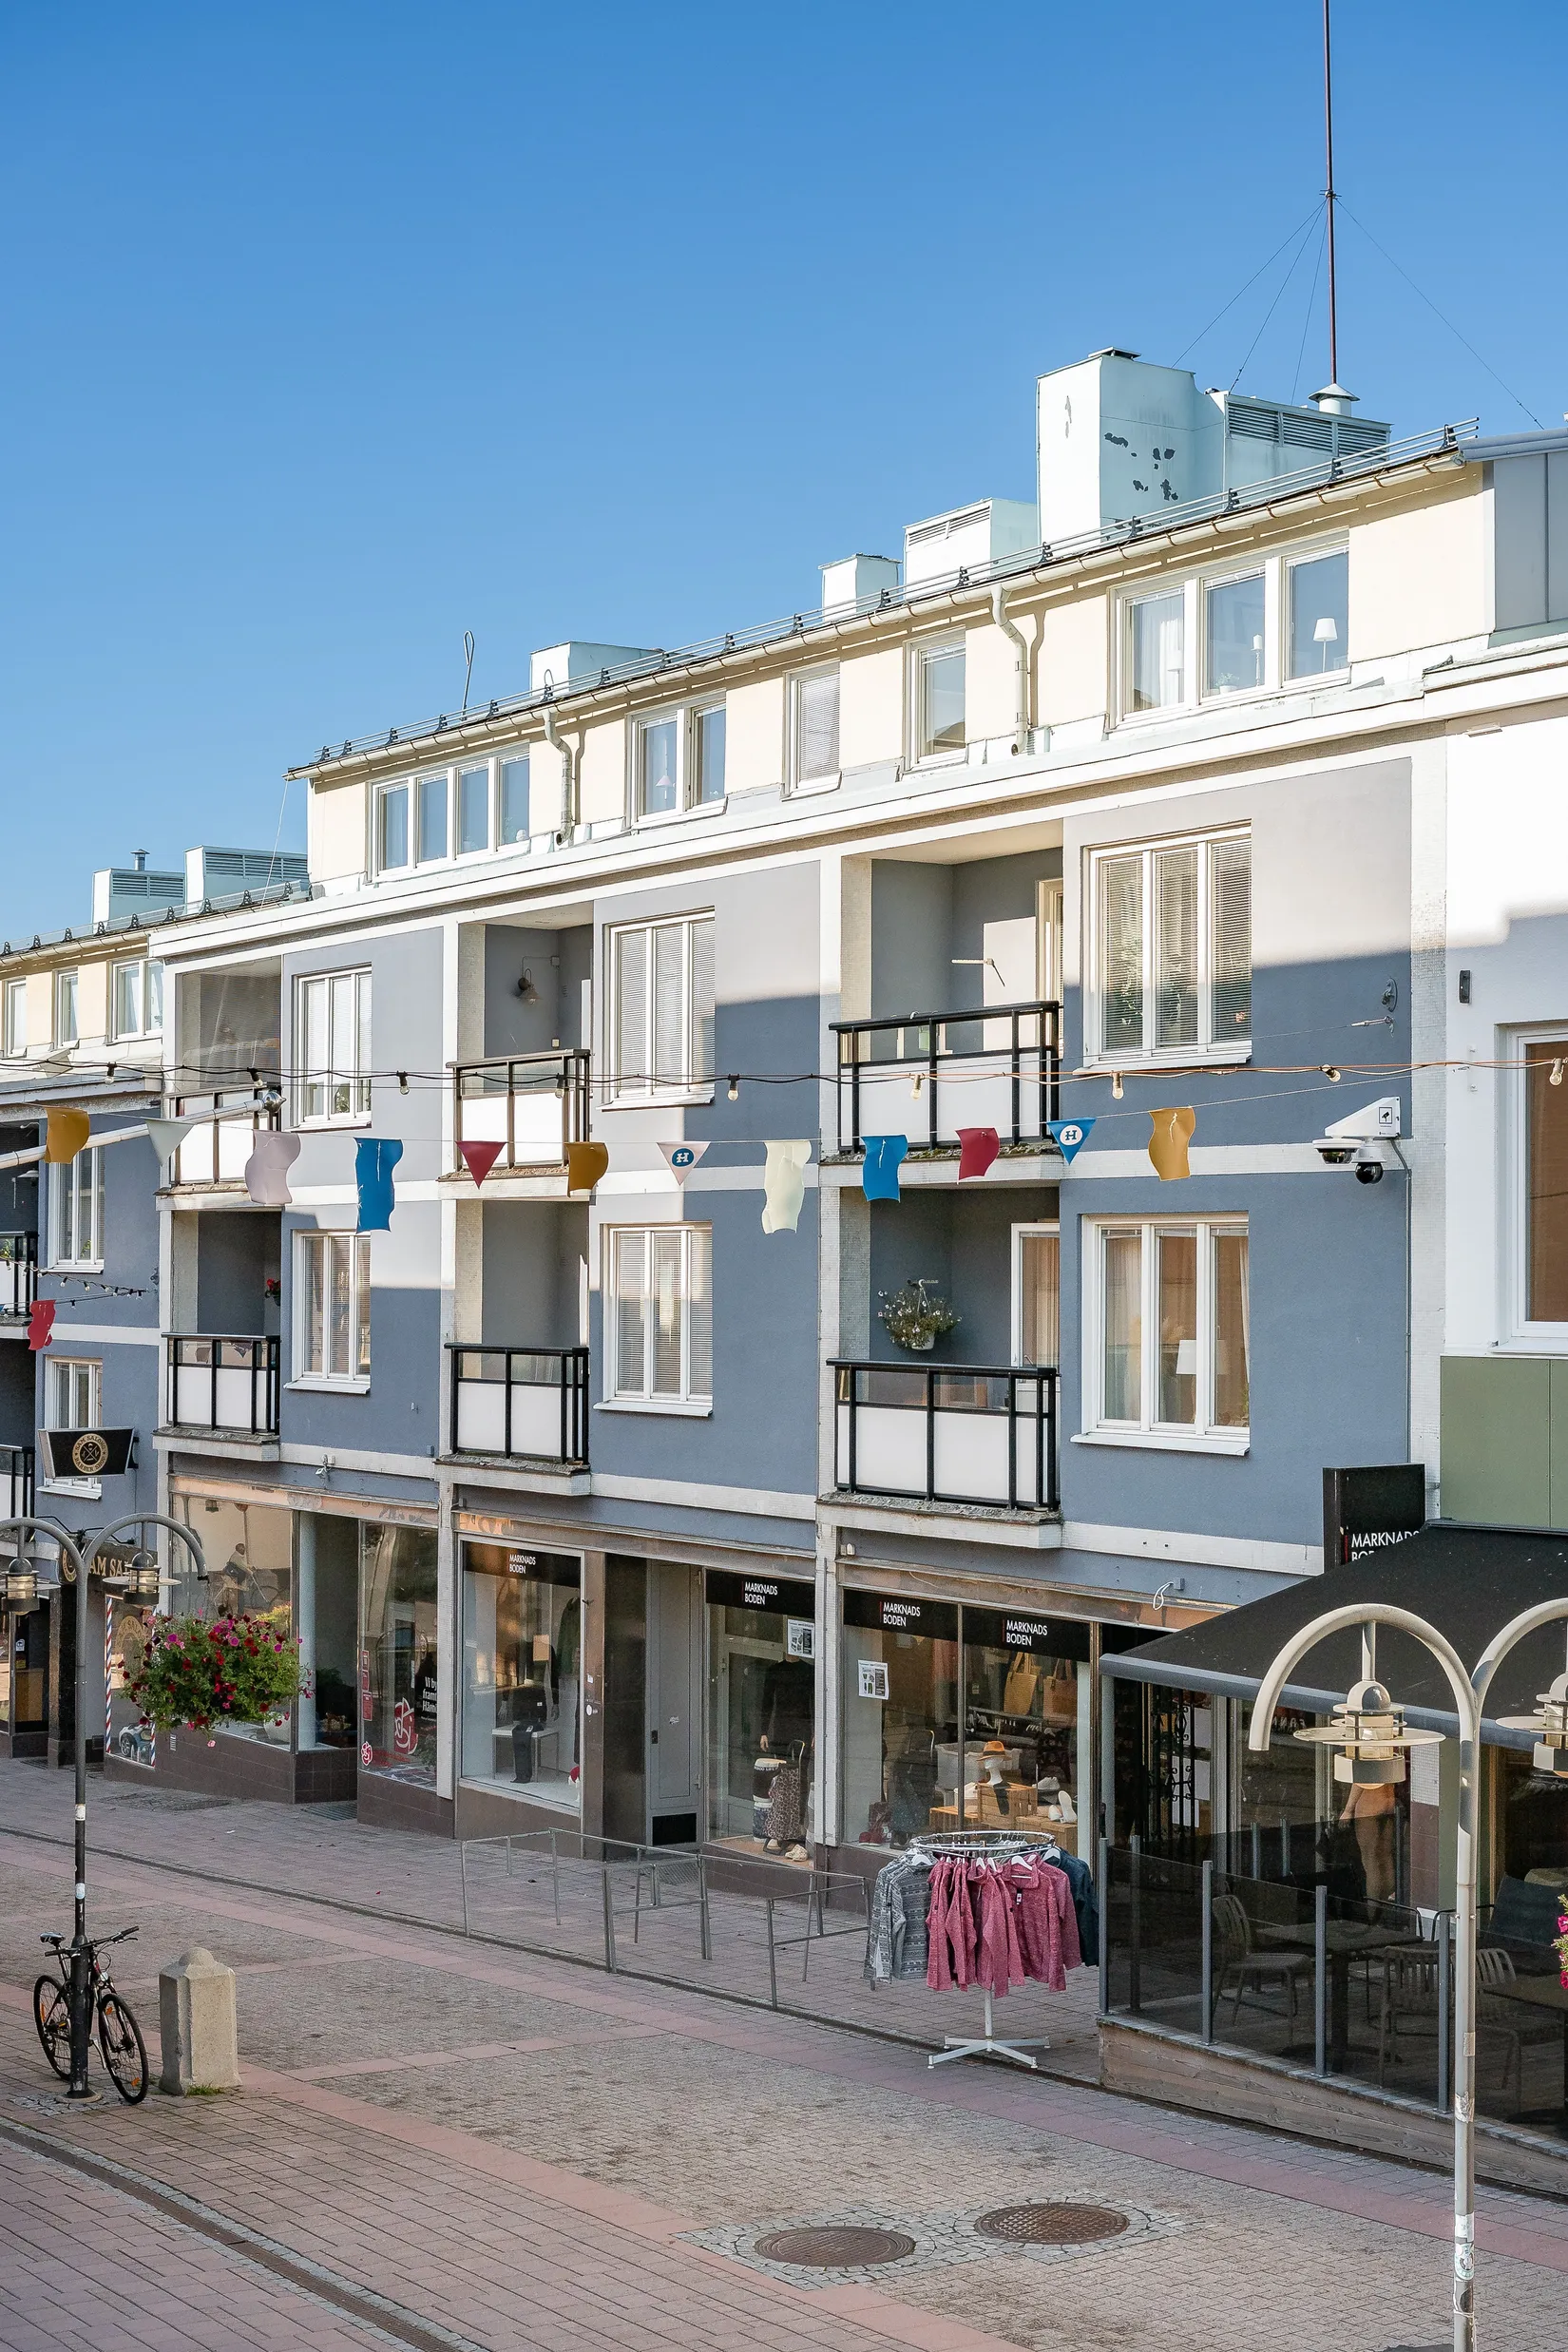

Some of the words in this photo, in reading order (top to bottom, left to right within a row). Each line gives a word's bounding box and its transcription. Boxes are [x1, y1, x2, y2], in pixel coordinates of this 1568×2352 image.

[74, 1457, 94, 1472] BARBER
[509, 1554, 536, 1566] MARKNADS
[508, 1563, 526, 1574] BODEN
[744, 1581, 778, 1596] MARKNADS
[744, 1593, 766, 1605] BODEN
[883, 1601, 921, 1616] MARKNADS
[883, 1614, 907, 1627] BODEN
[1006, 1619, 1048, 1635] MARKNADS
[1006, 1632, 1032, 1646] BODEN
